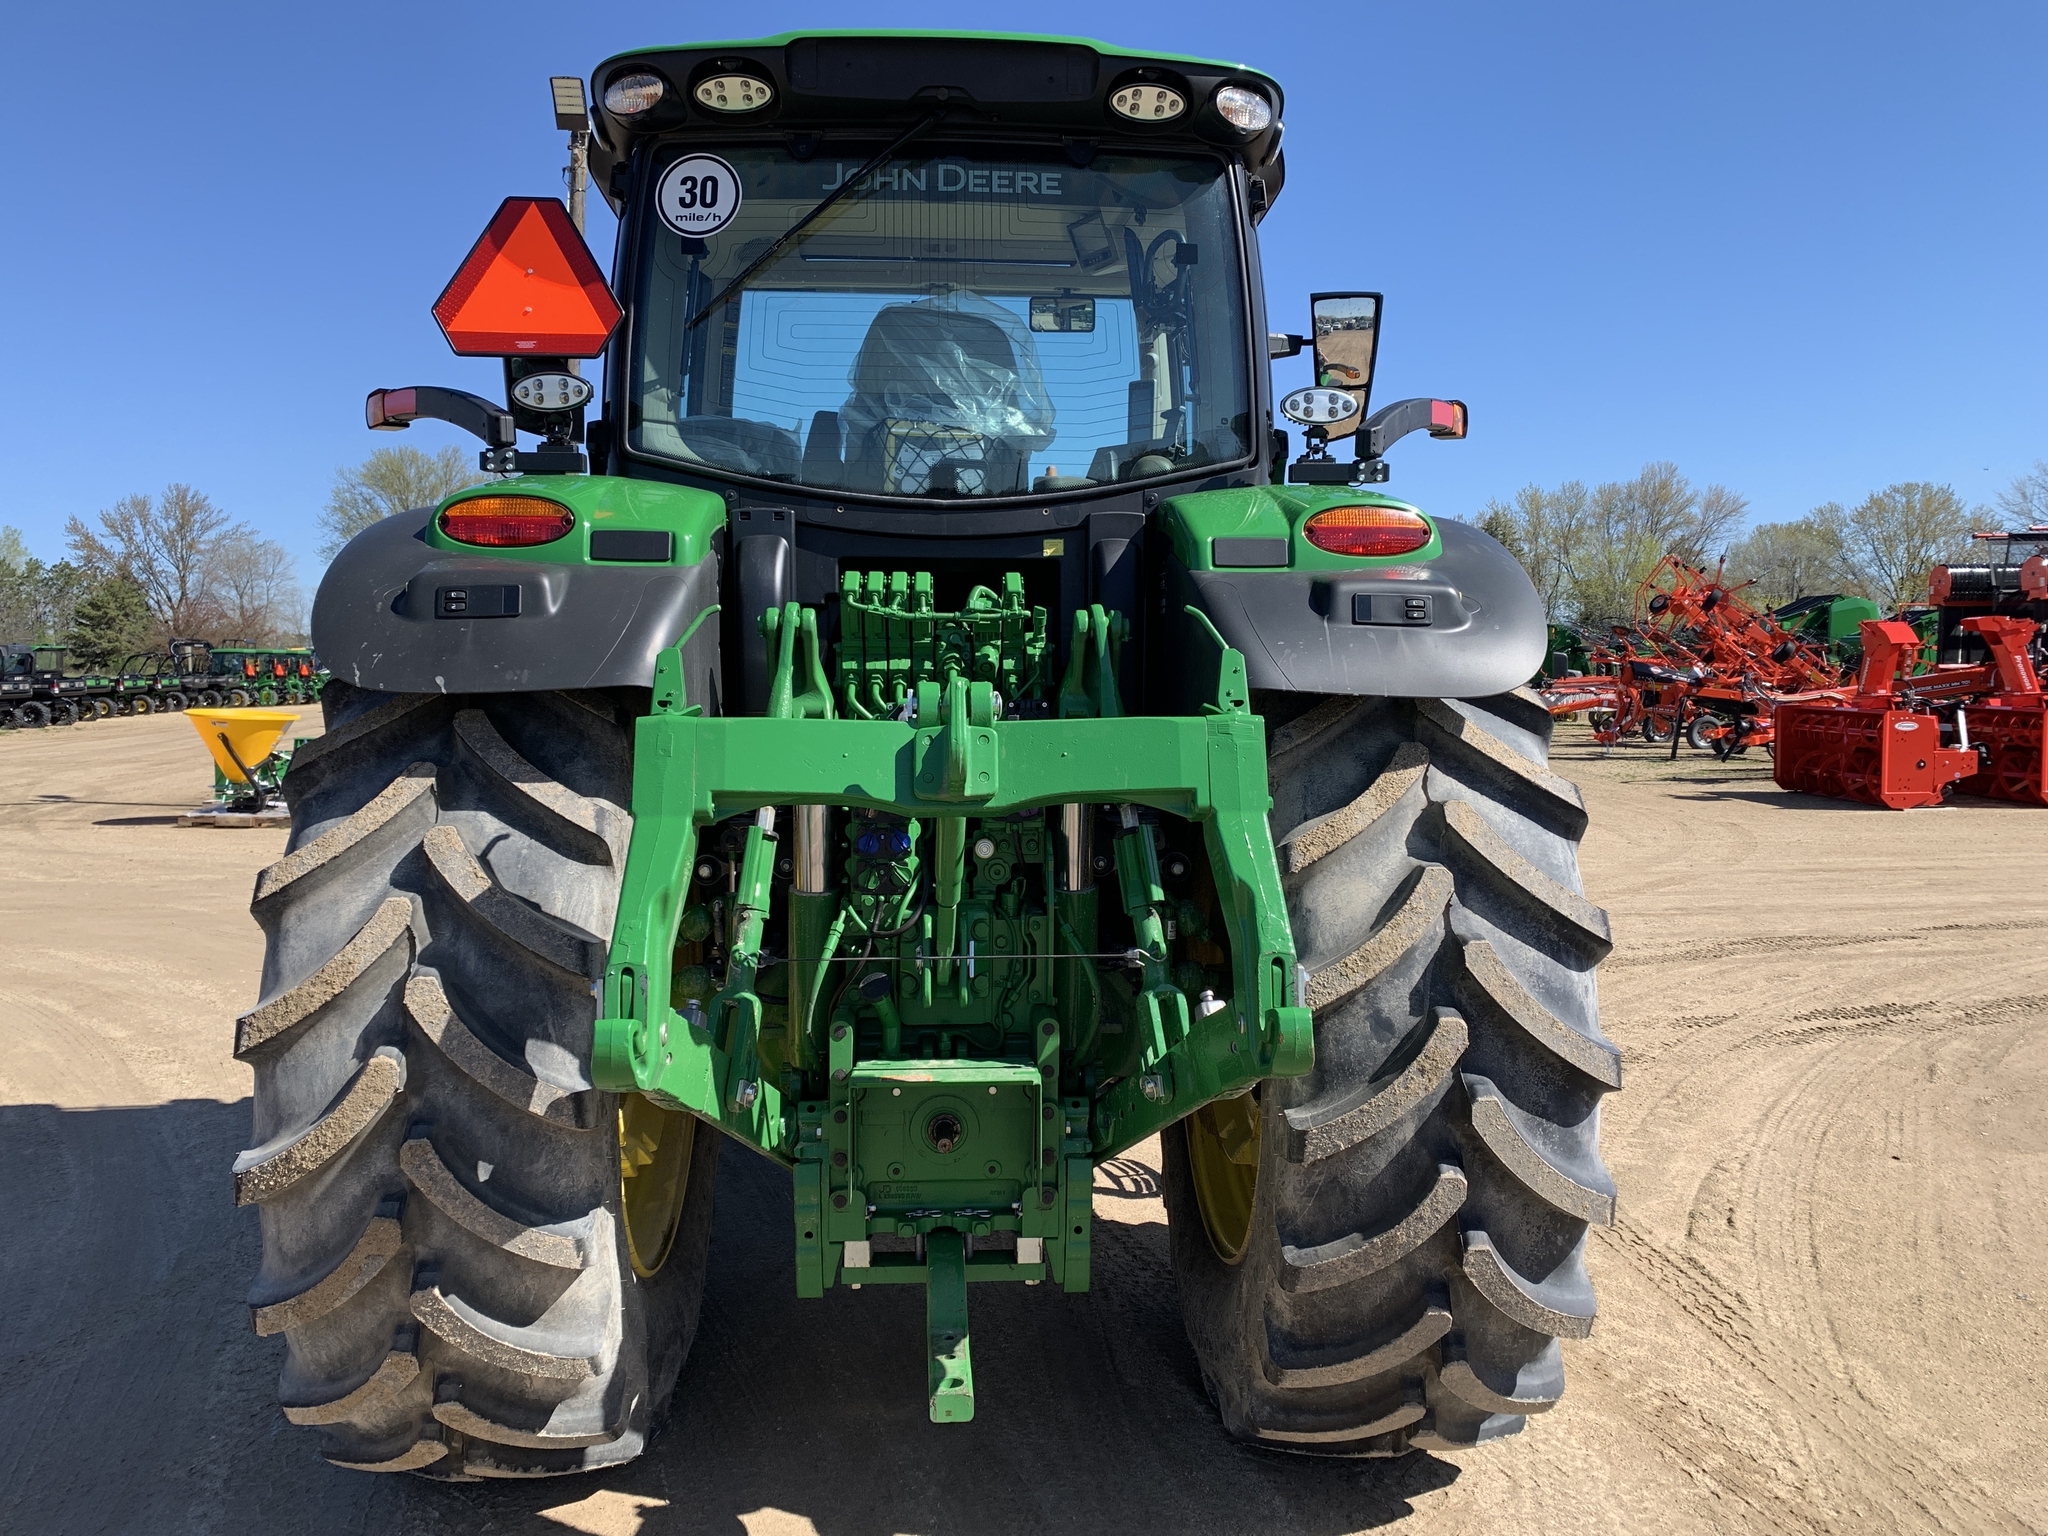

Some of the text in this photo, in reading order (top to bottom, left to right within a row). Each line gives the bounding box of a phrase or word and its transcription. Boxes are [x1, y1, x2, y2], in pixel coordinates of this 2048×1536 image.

[678, 175, 719, 209] 30
[938, 164, 1062, 195] DEERE
[675, 212, 722, 222] mile/h
